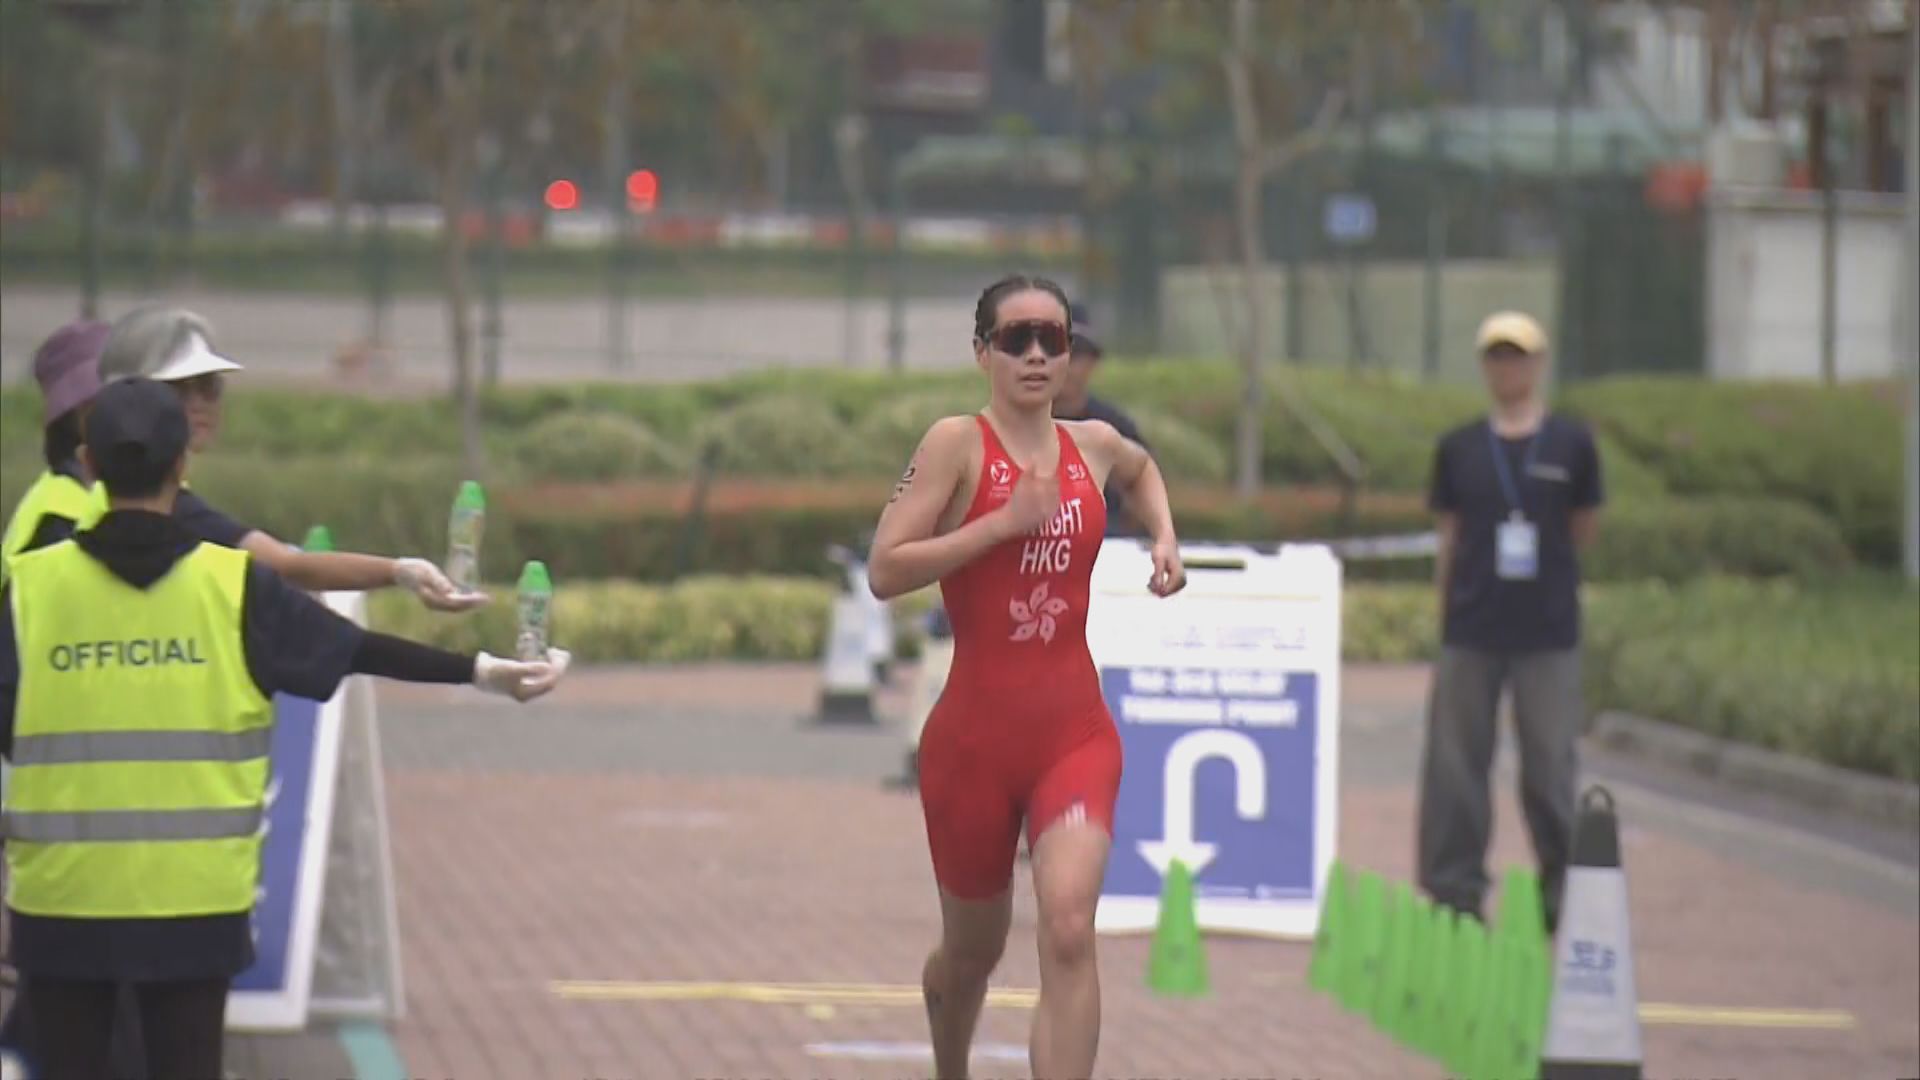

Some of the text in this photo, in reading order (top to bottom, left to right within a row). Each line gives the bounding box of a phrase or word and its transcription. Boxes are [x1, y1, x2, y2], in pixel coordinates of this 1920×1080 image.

[1023, 498, 1083, 537] IGHT
[1019, 538, 1072, 575] HKG
[48, 636, 206, 672] OFFICIAL
